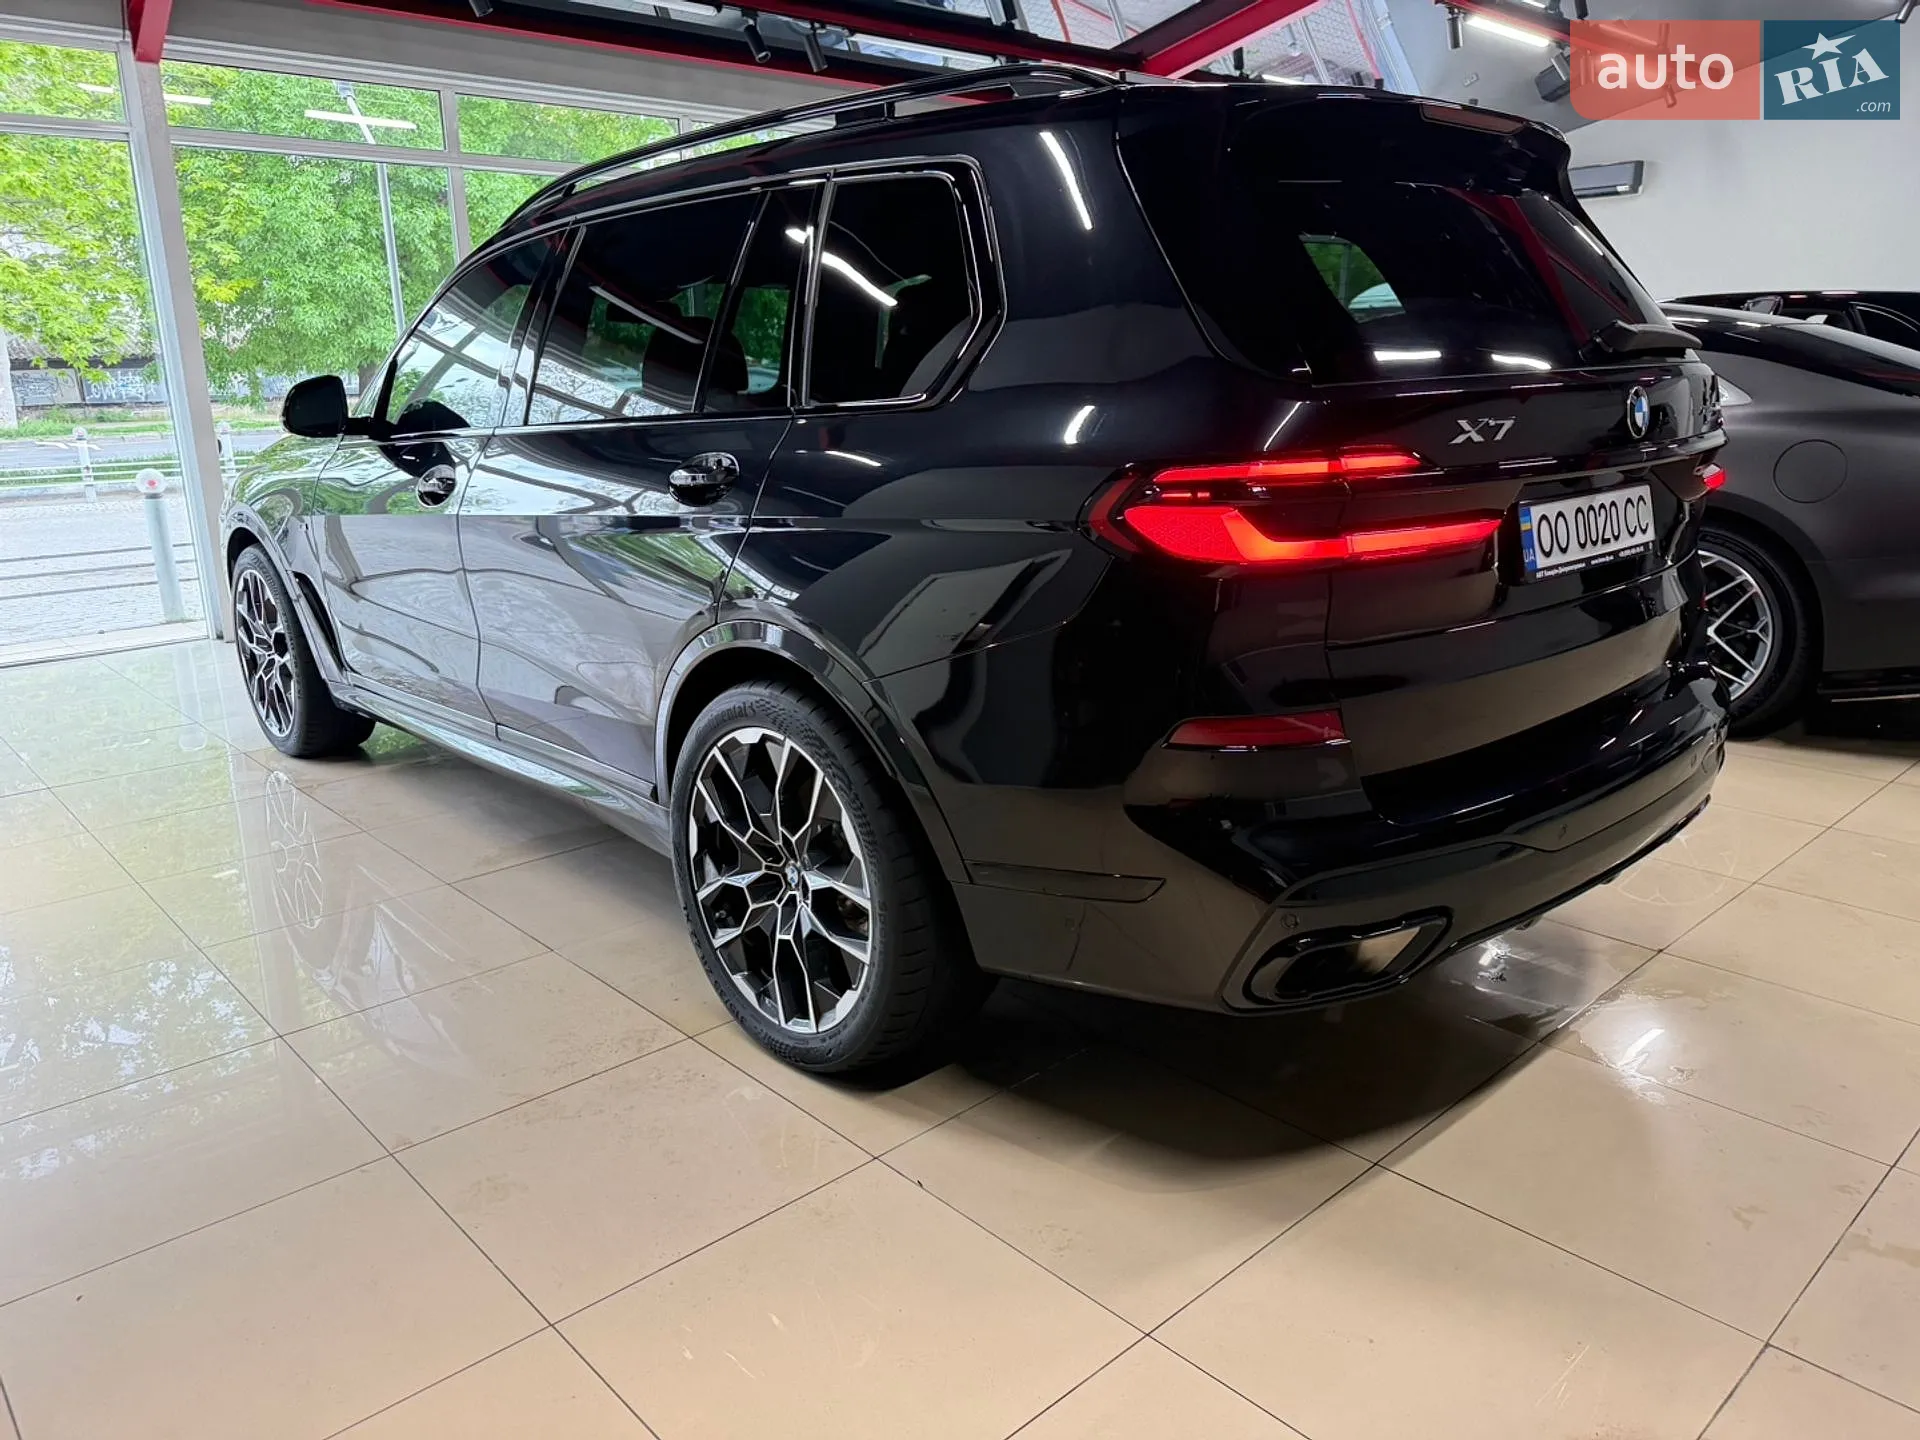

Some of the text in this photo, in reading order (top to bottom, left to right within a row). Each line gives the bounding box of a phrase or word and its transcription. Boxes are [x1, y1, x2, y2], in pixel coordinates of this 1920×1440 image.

[1449, 416, 1516, 445] X7
[1537, 494, 1649, 558] OO 0020 CC
[1523, 549, 1536, 564] UA
